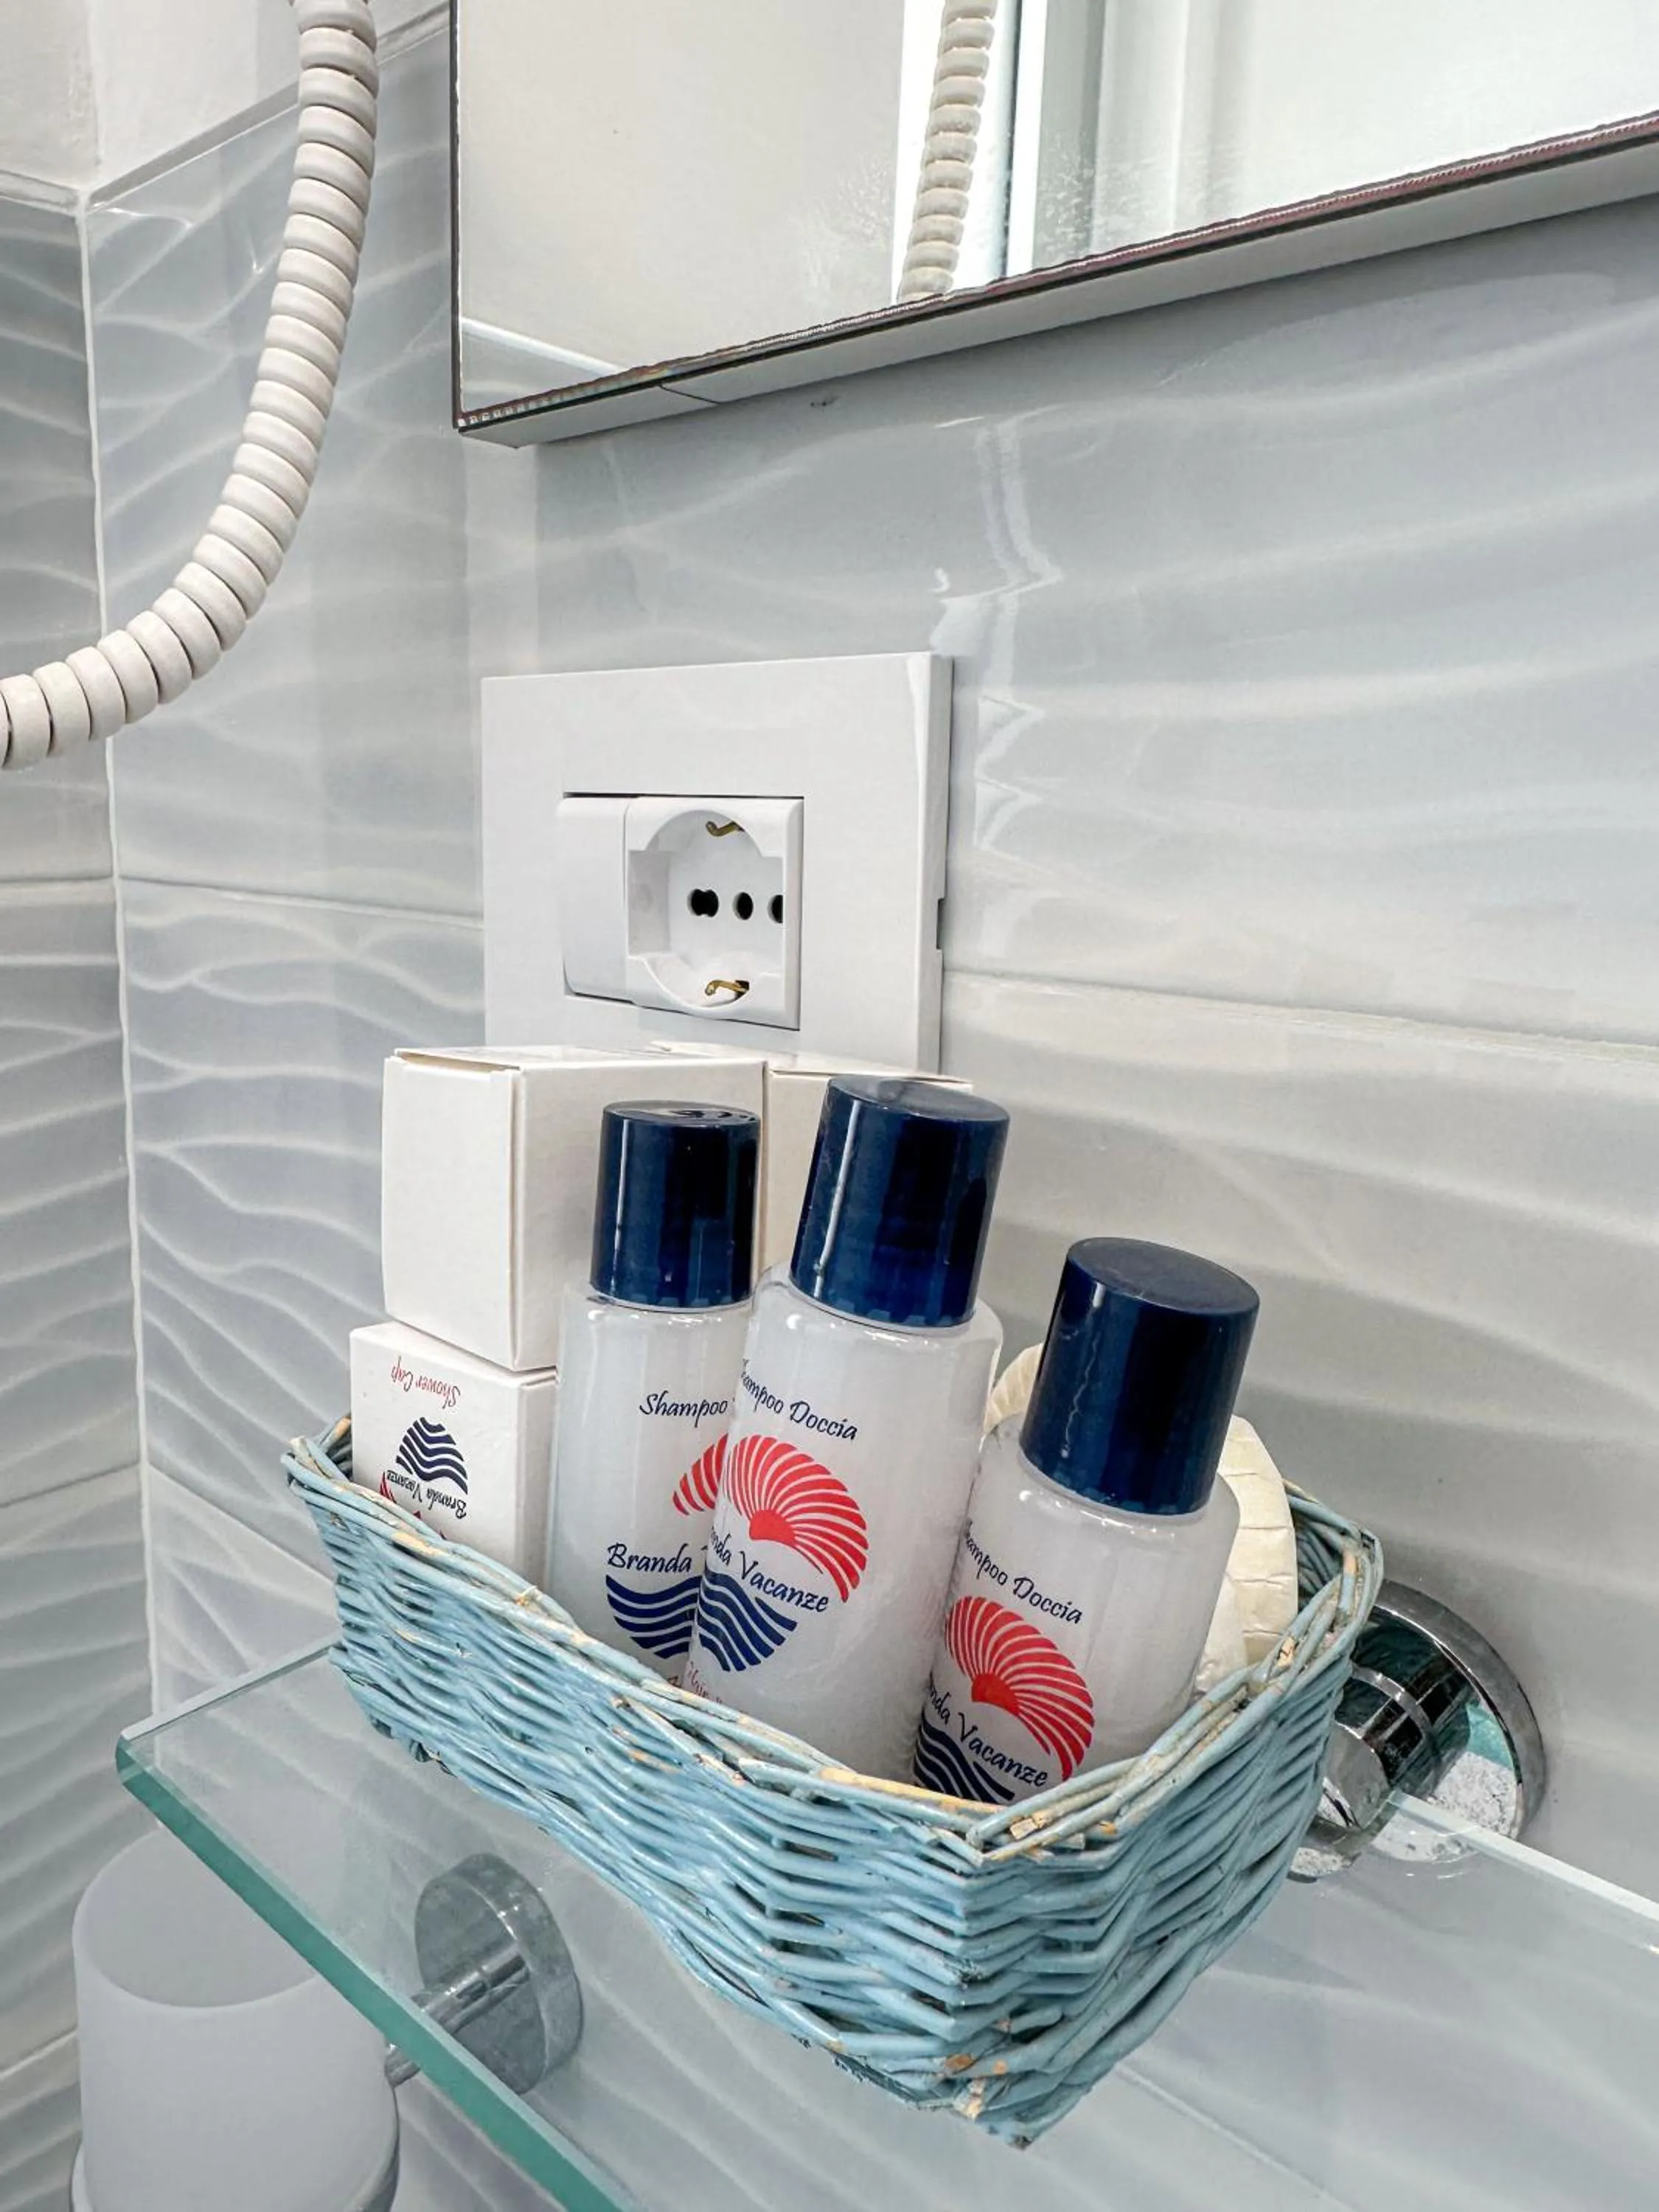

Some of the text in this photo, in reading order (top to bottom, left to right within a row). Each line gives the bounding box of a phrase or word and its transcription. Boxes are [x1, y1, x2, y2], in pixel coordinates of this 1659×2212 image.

[390, 1354, 462, 1410] Shower Cap
[639, 1390, 728, 1427] Shampoo
[789, 1400, 859, 1441] Doccia
[386, 1469, 467, 1520] Branda Vacanze
[606, 1543, 693, 1573] Branda
[710, 1526, 830, 1613] nda Vacanze
[1012, 1576, 1083, 1624] Doccia
[928, 1674, 1048, 1787] nda Vacanze
